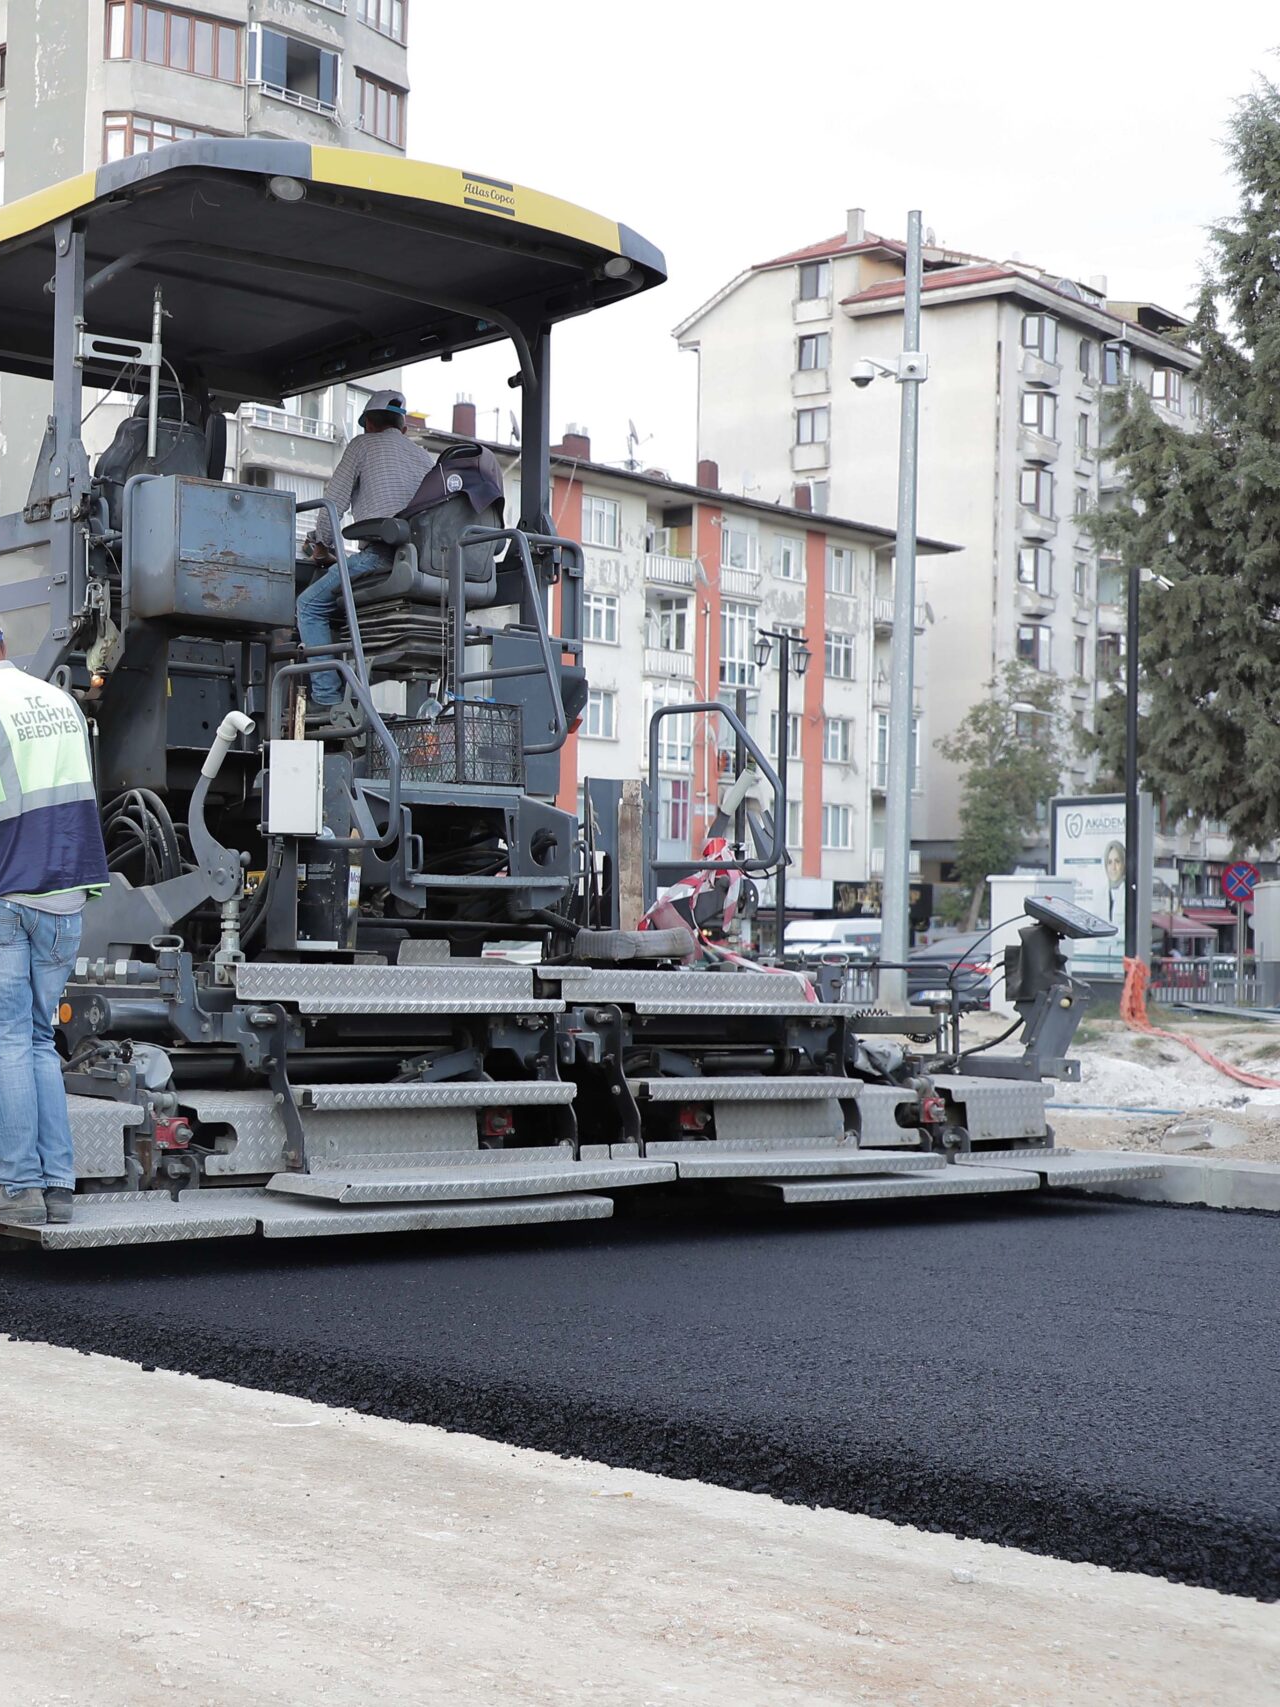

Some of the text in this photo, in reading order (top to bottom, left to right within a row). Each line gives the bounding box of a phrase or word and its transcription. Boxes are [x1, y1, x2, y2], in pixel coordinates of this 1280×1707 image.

[463, 183, 515, 205] Atlas Copco
[24, 696, 49, 710] T.C.
[10, 707, 75, 727] KÜTAHYA
